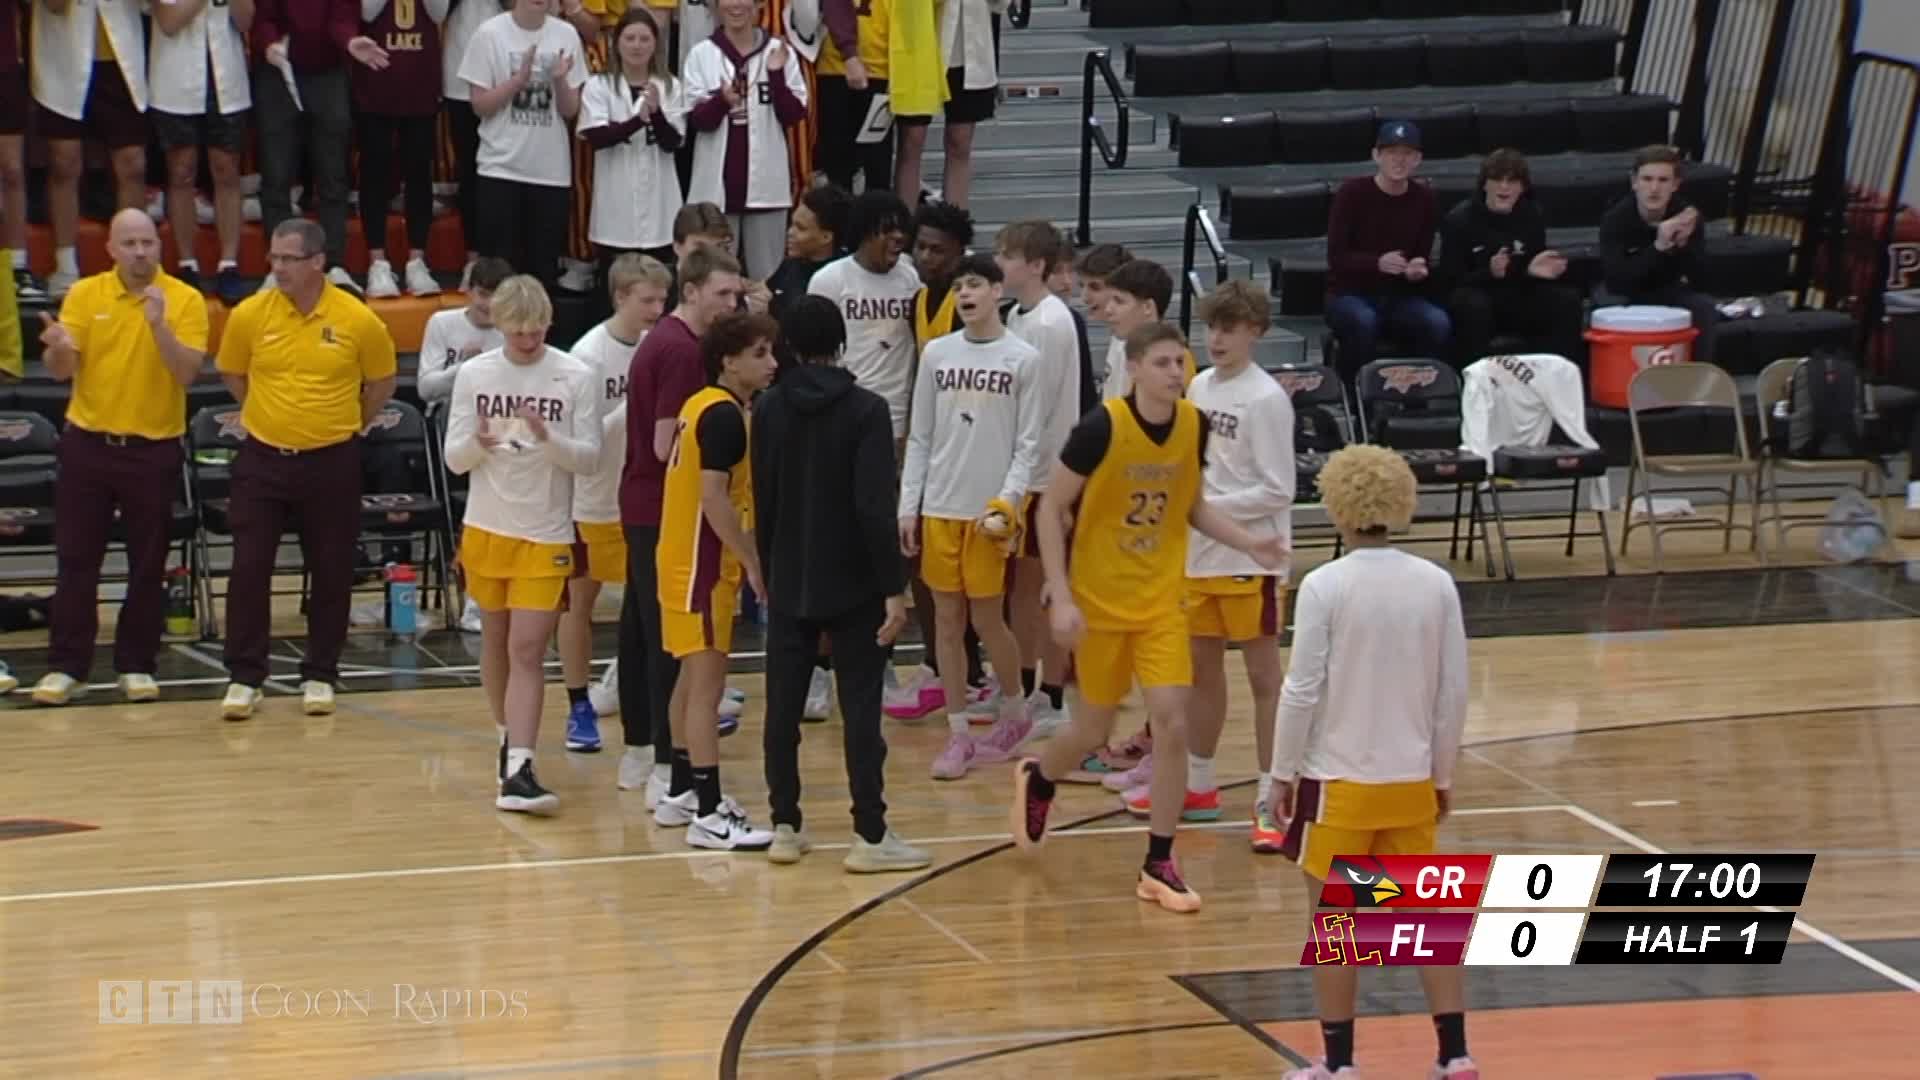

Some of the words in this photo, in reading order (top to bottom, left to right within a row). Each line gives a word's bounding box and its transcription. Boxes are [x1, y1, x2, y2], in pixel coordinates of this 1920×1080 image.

[386, 32, 423, 51] LAKE
[935, 367, 1013, 396] RANGER
[1124, 489, 1169, 527] 23
